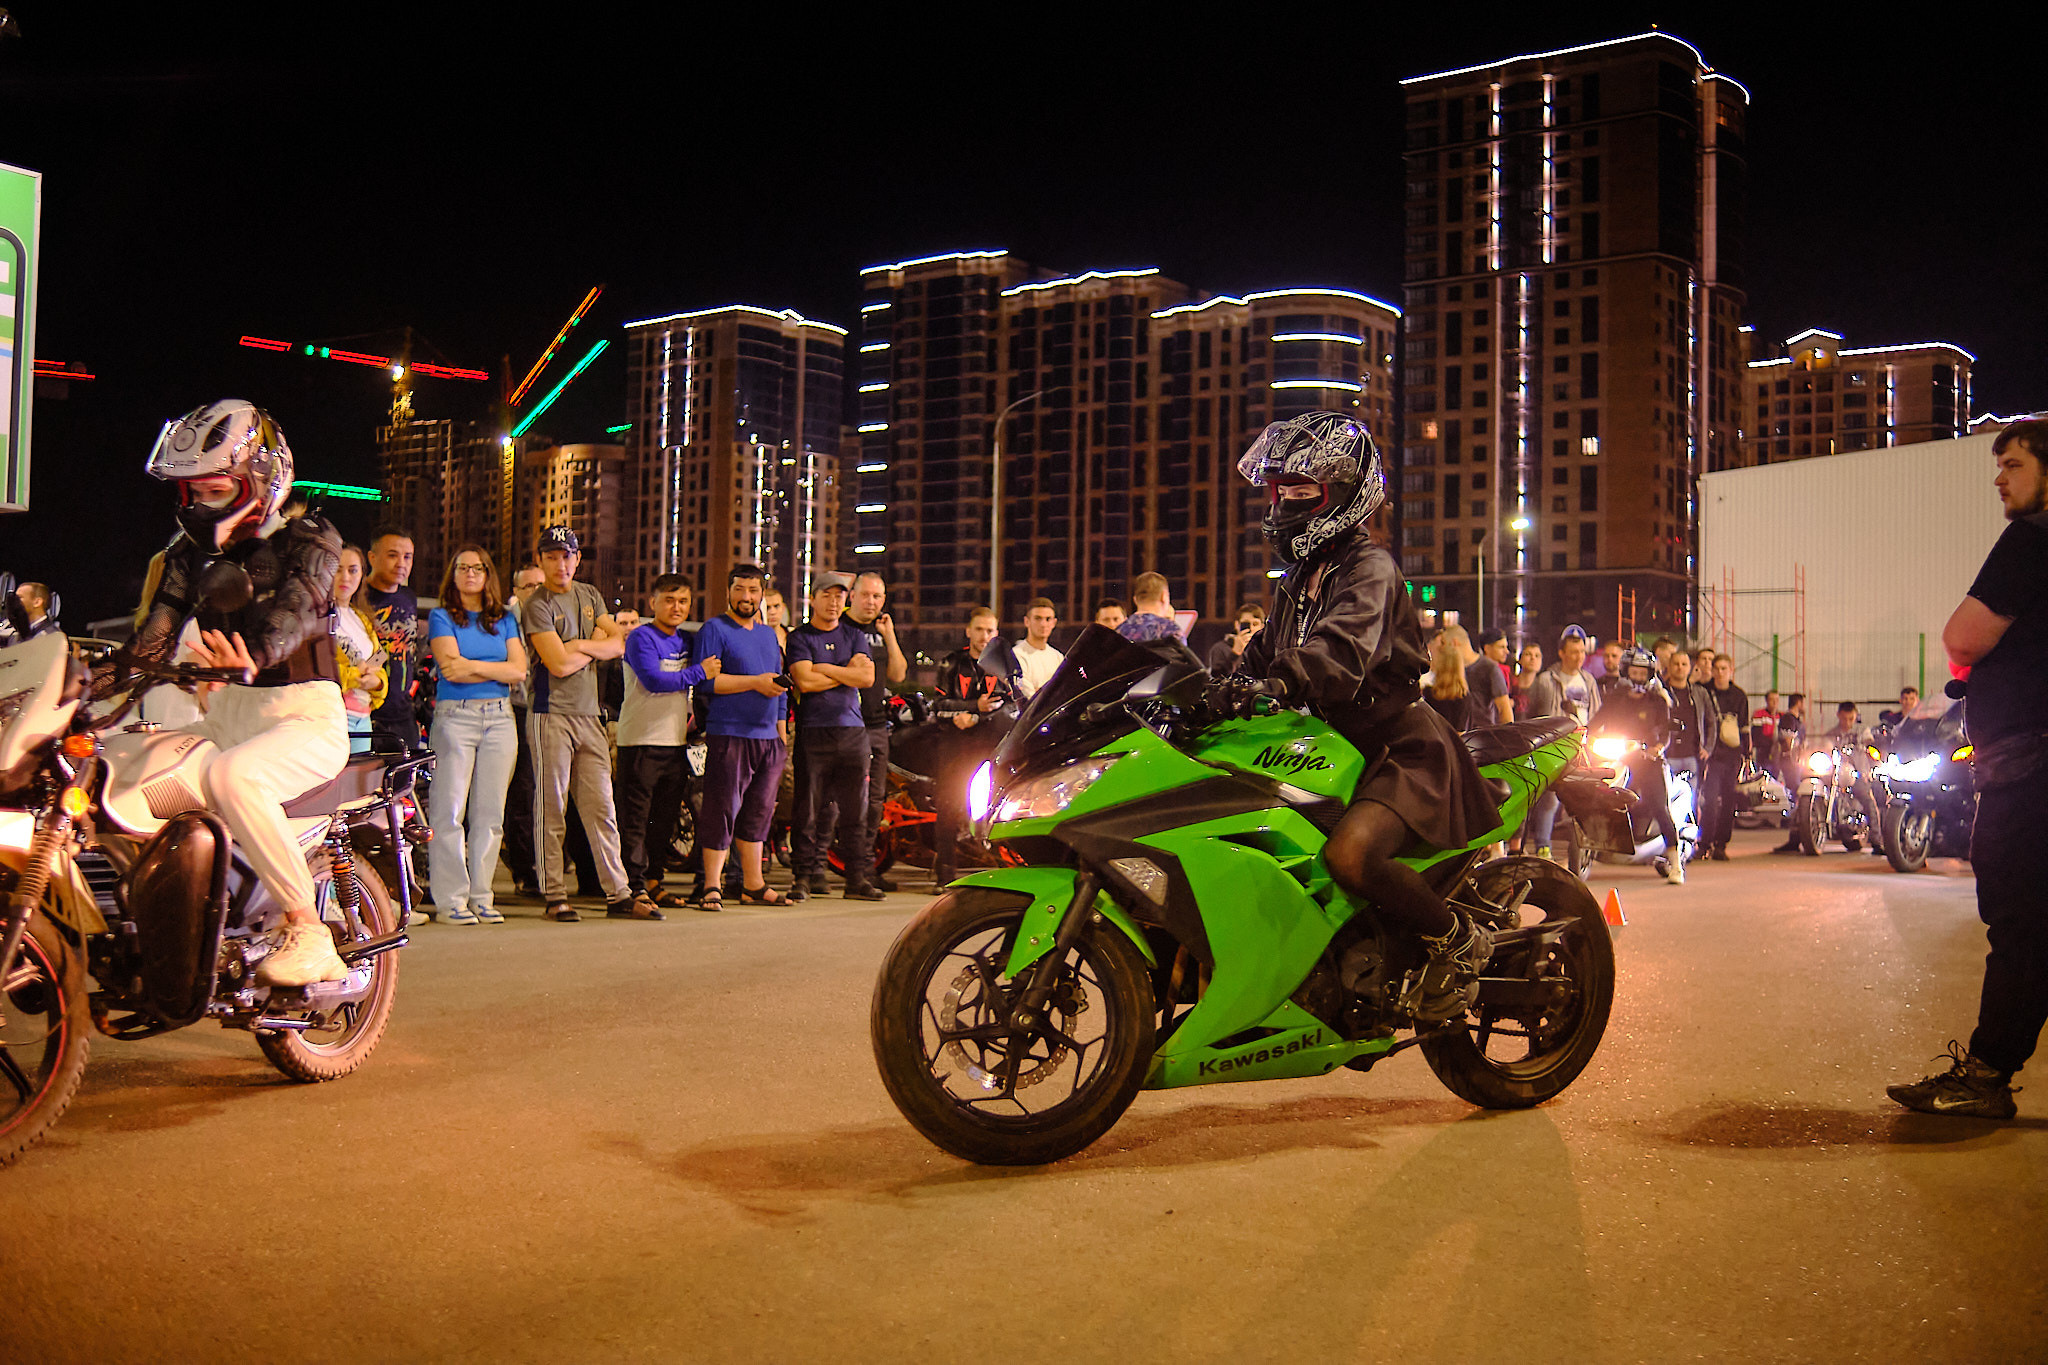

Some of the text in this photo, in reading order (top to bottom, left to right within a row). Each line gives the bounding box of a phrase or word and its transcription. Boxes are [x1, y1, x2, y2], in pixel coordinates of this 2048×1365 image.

[552, 527, 566, 542] NY
[1252, 745, 1332, 776] Ninja
[1198, 1027, 1322, 1077] Kawasaki
